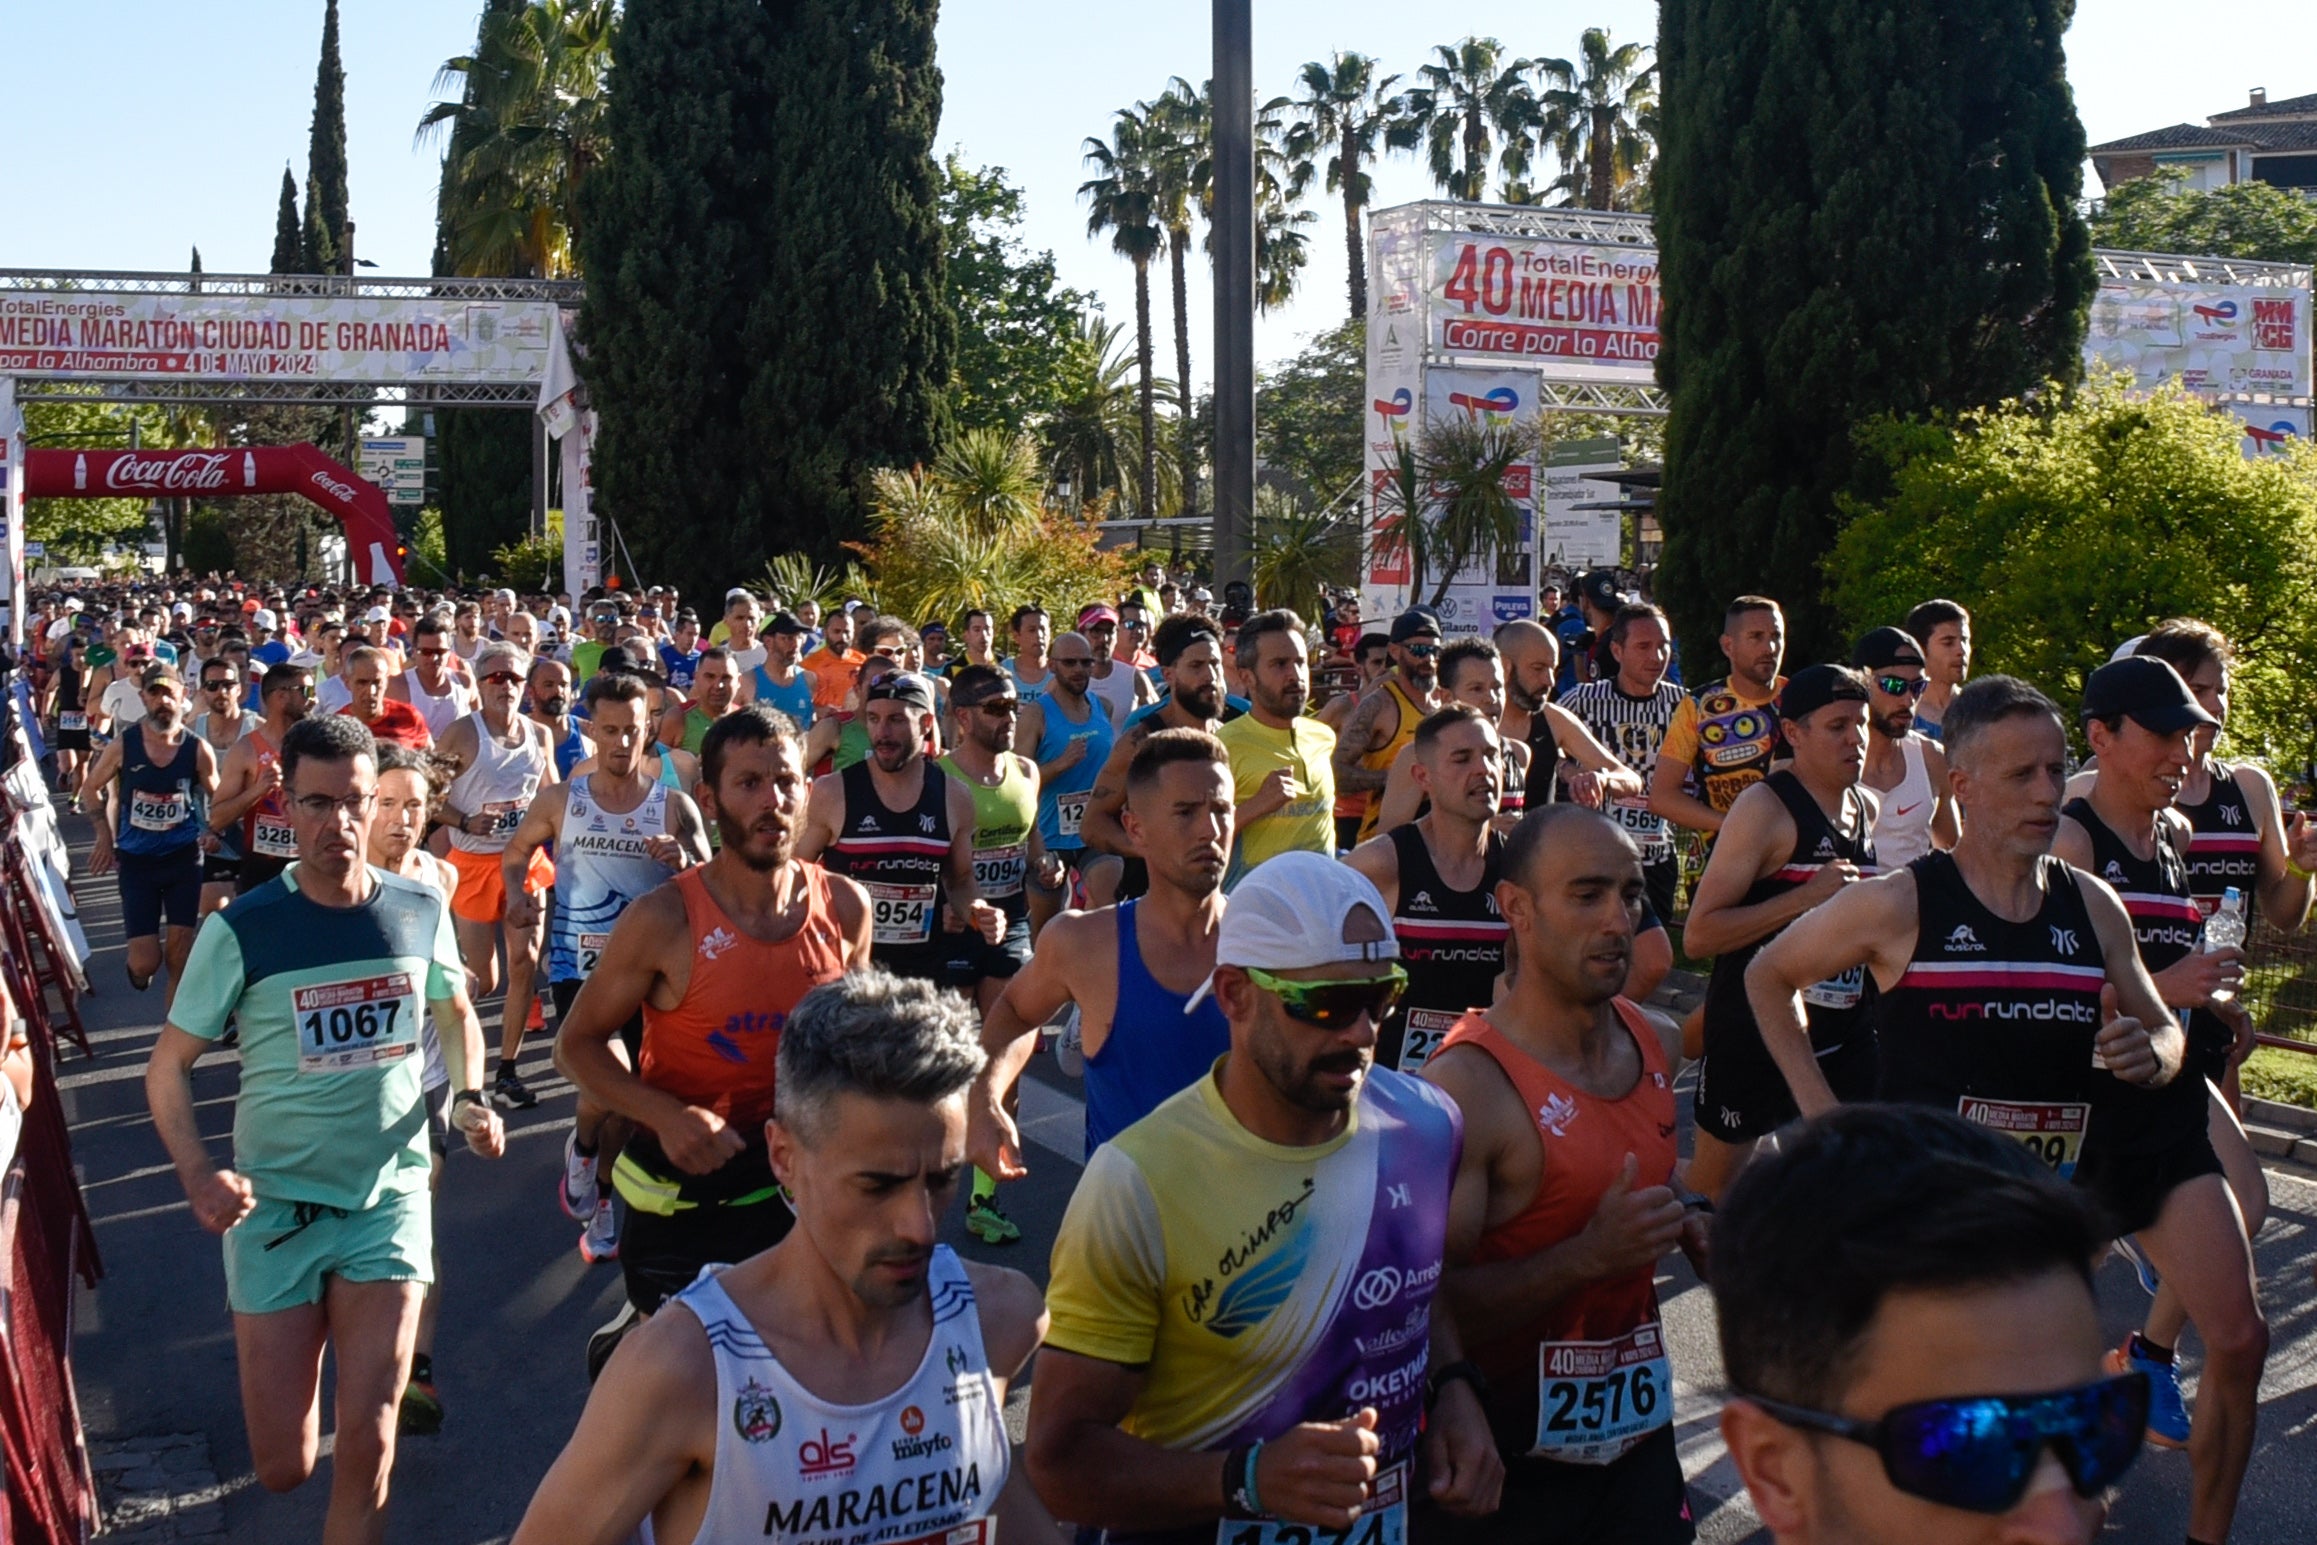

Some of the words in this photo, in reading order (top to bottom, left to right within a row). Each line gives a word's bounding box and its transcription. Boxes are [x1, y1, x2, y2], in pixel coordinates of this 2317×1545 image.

[1444, 244, 1514, 316] 40
[1518, 277, 1618, 325] MEDIA
[0, 317, 72, 347] MEDIA
[80, 314, 195, 349] MARATÓN
[203, 320, 291, 350] CIUDAD
[300, 322, 330, 351] DE
[336, 322, 450, 351] GRANADA
[1445, 321, 1517, 350] Corre
[1523, 332, 1567, 355] por
[1574, 330, 1596, 355] la
[37, 352, 56, 368] la
[60, 352, 158, 370] Alhambra
[184, 353, 196, 373] 4
[200, 353, 221, 373] DE
[225, 354, 271, 374] MAYO
[274, 354, 319, 375] 2024
[2249, 369, 2293, 379] GRANADA
[106, 453, 231, 489] Coca-Cola
[311, 471, 359, 503] Coca-Cola
[1495, 601, 1529, 611] PULEVA
[1440, 622, 1479, 633] Gilauto
[134, 802, 177, 819] 4260
[1612, 807, 1660, 829] 1569
[975, 858, 1021, 882] 3094
[875, 901, 924, 924] 954
[1944, 943, 1987, 951] austral
[300, 989, 320, 1009] 40
[305, 999, 401, 1047] 1067
[1412, 1012, 1428, 1029] 40
[1965, 1102, 1989, 1125] 40
[1549, 1347, 1575, 1376] 40
[1546, 1365, 1657, 1433] 2576
[798, 1427, 856, 1467] als
[892, 1431, 953, 1461] mayfo
[763, 1461, 981, 1537] MARACENA
[872, 1512, 963, 1541] ATLETISMO
